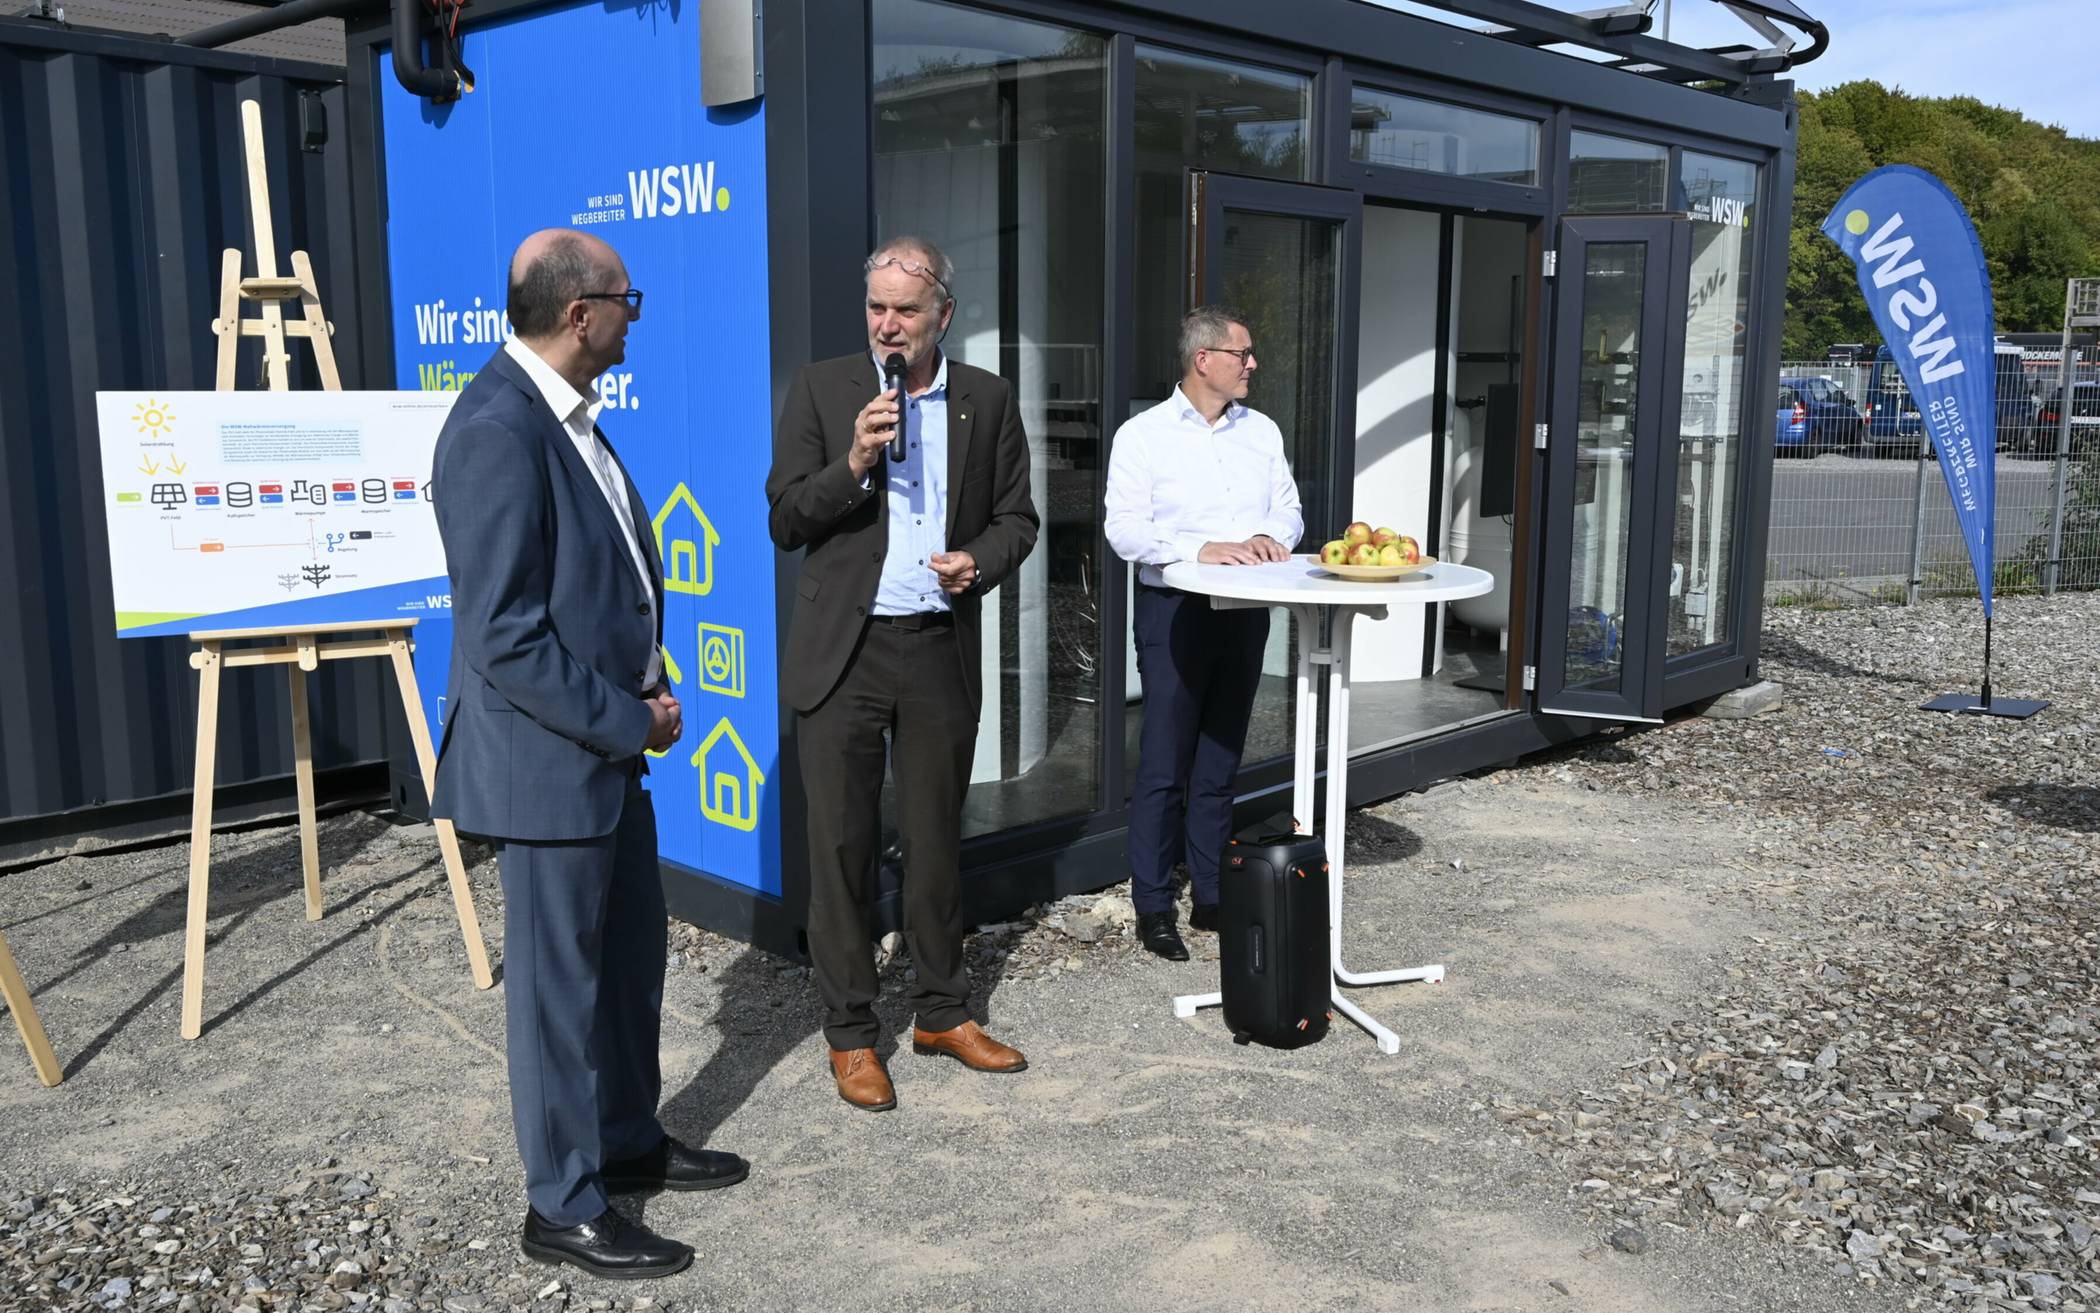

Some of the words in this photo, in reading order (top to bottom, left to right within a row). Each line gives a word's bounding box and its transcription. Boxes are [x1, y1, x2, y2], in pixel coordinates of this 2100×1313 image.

[588, 196, 603, 208] WIR
[604, 193, 624, 206] SIND
[571, 209, 626, 225] WEGBEREITER
[415, 299, 458, 345] Wir
[425, 594, 452, 609] WS
